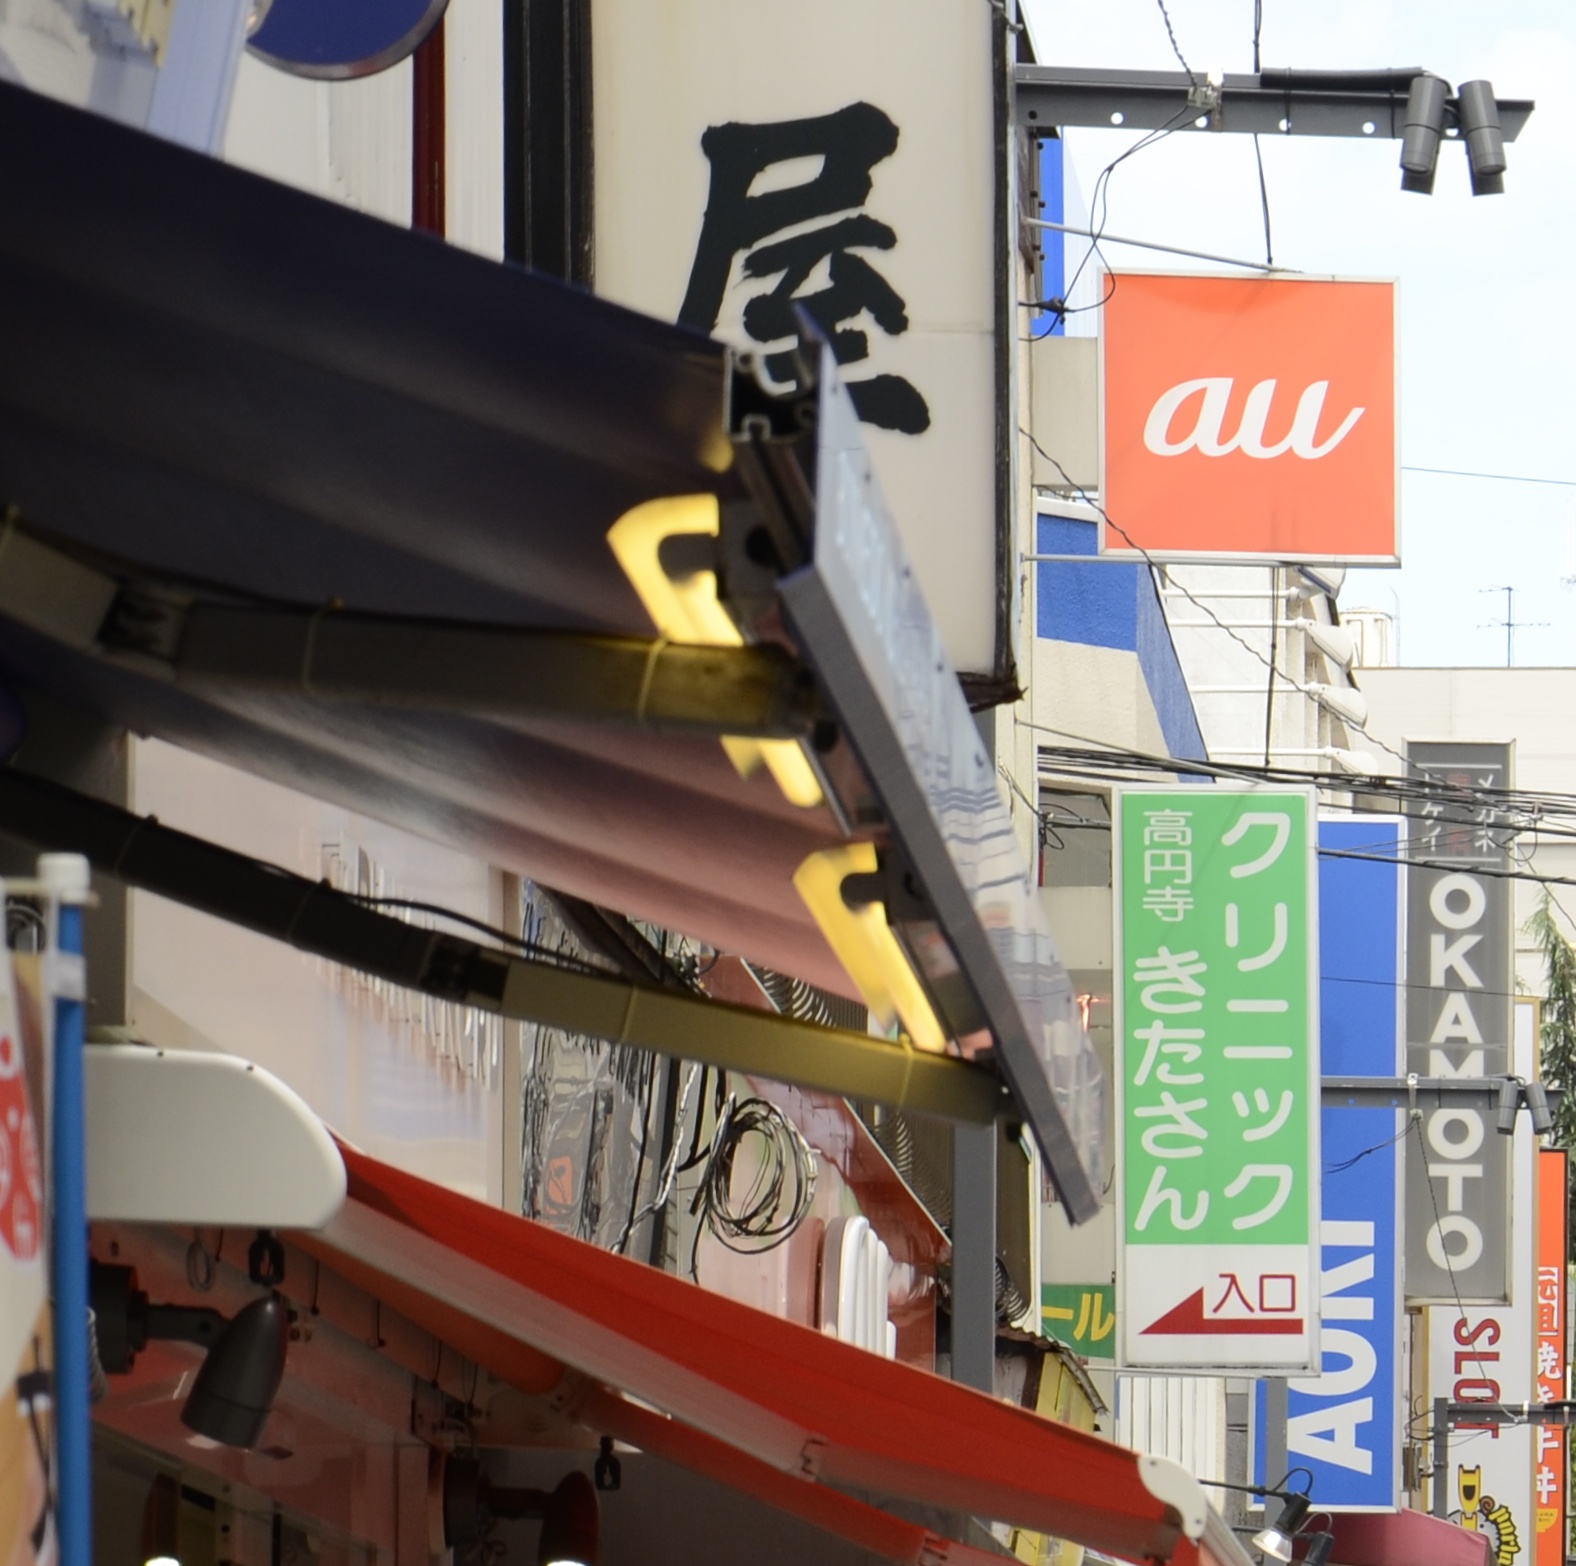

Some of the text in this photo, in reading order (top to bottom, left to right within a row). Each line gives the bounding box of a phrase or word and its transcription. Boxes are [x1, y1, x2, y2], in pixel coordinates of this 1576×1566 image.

[1142, 377, 1366, 459] au
[1143, 810, 1194, 923] 高円寺
[1134, 946, 1209, 1231] きたさん
[1222, 812, 1295, 1230] クリニック
[1427, 873, 1486, 1271] OKAMOTO
[1213, 1273, 1296, 1314] 入口
